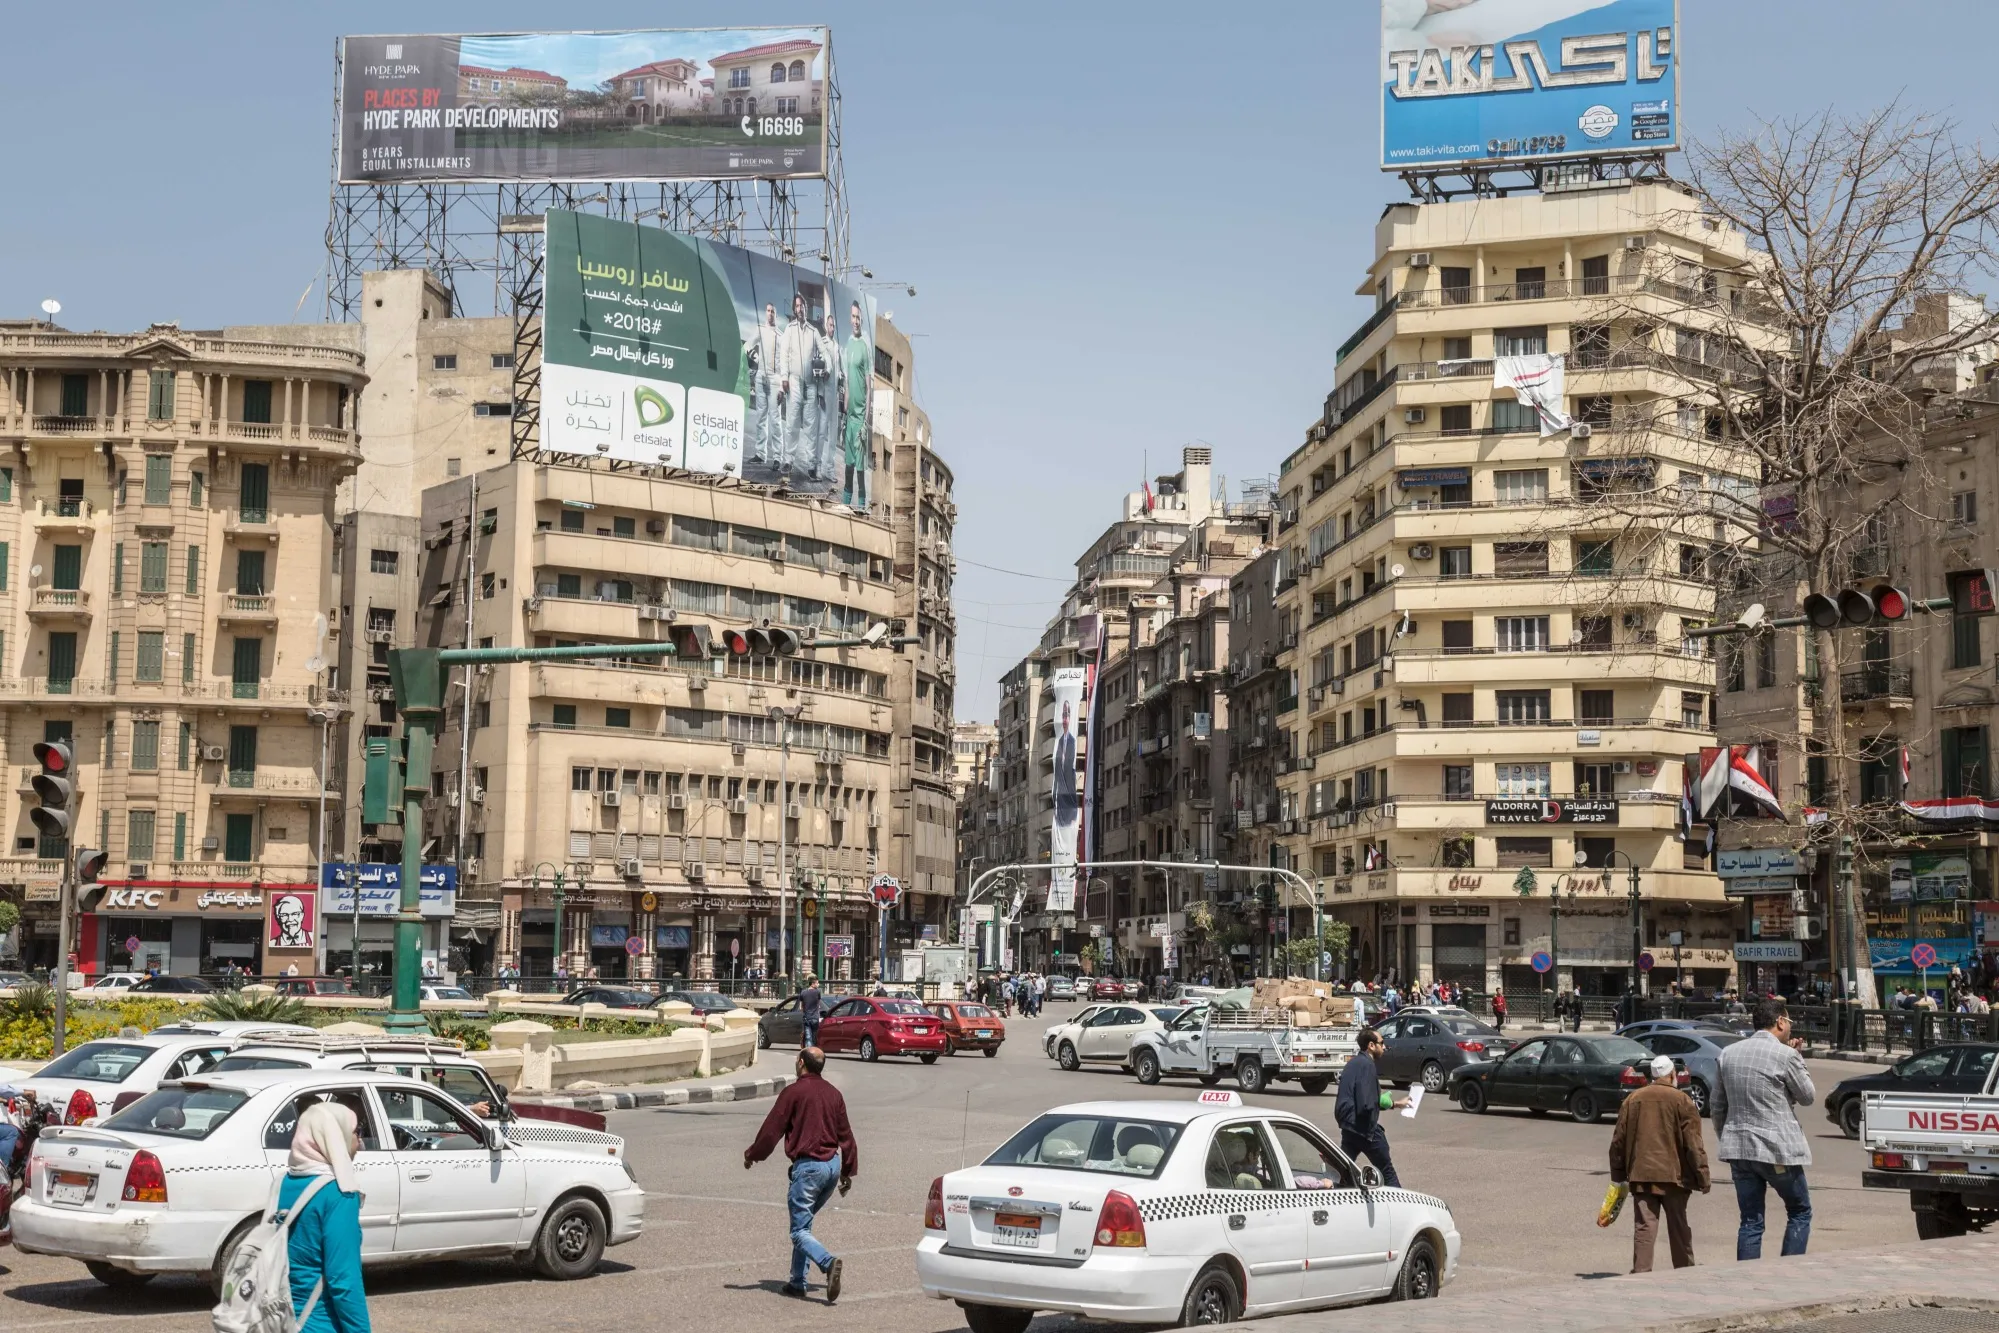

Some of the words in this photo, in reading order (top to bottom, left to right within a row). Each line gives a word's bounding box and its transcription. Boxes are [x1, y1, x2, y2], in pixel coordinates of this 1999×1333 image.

[365, 65, 392, 76] HYDE
[395, 64, 421, 75] PARK
[364, 87, 418, 109] PLACES
[422, 87, 441, 107] BY
[364, 109, 399, 131] HYDE
[403, 108, 440, 129] PARK
[445, 107, 559, 129] DEVELOPMENTS
[757, 116, 804, 136] 16696
[363, 148, 368, 159] 8
[372, 146, 403, 158] YEARS
[1390, 144, 1480, 158] www.taki-vita.com
[363, 160, 392, 172] EQUAL
[396, 157, 471, 171] INSTALLMENTS
[577, 254, 635, 286] روسيا
[640, 269, 689, 293] سافر
[590, 344, 613, 357] مصر
[614, 344, 641, 363] أبطال
[642, 350, 660, 366] كل
[693, 413, 739, 433] etisalat
[633, 432, 672, 448] etisalat
[692, 429, 738, 450] sports
[1490, 802, 1538, 810] ALDORRA
[1564, 802, 1592, 812] للسياحة
[1592, 802, 1615, 811] الدرة
[1720, 855, 1762, 872] للسياحة
[1765, 857, 1794, 872] سفير
[875, 877, 896, 887] مترو
[1448, 875, 1483, 892] لبنان
[106, 889, 164, 907] KFC
[197, 891, 237, 909] كنتاكي
[236, 891, 263, 908] دجاج
[876, 886, 896, 901] M
[337, 904, 379, 912] EGYTAIR
[677, 897, 703, 910] الحربي
[703, 897, 726, 912] الإنتاج
[1737, 947, 1763, 957] SAFIR
[1765, 947, 1798, 957] TRAVEL
[1204, 1093, 1230, 1102] TAXI
